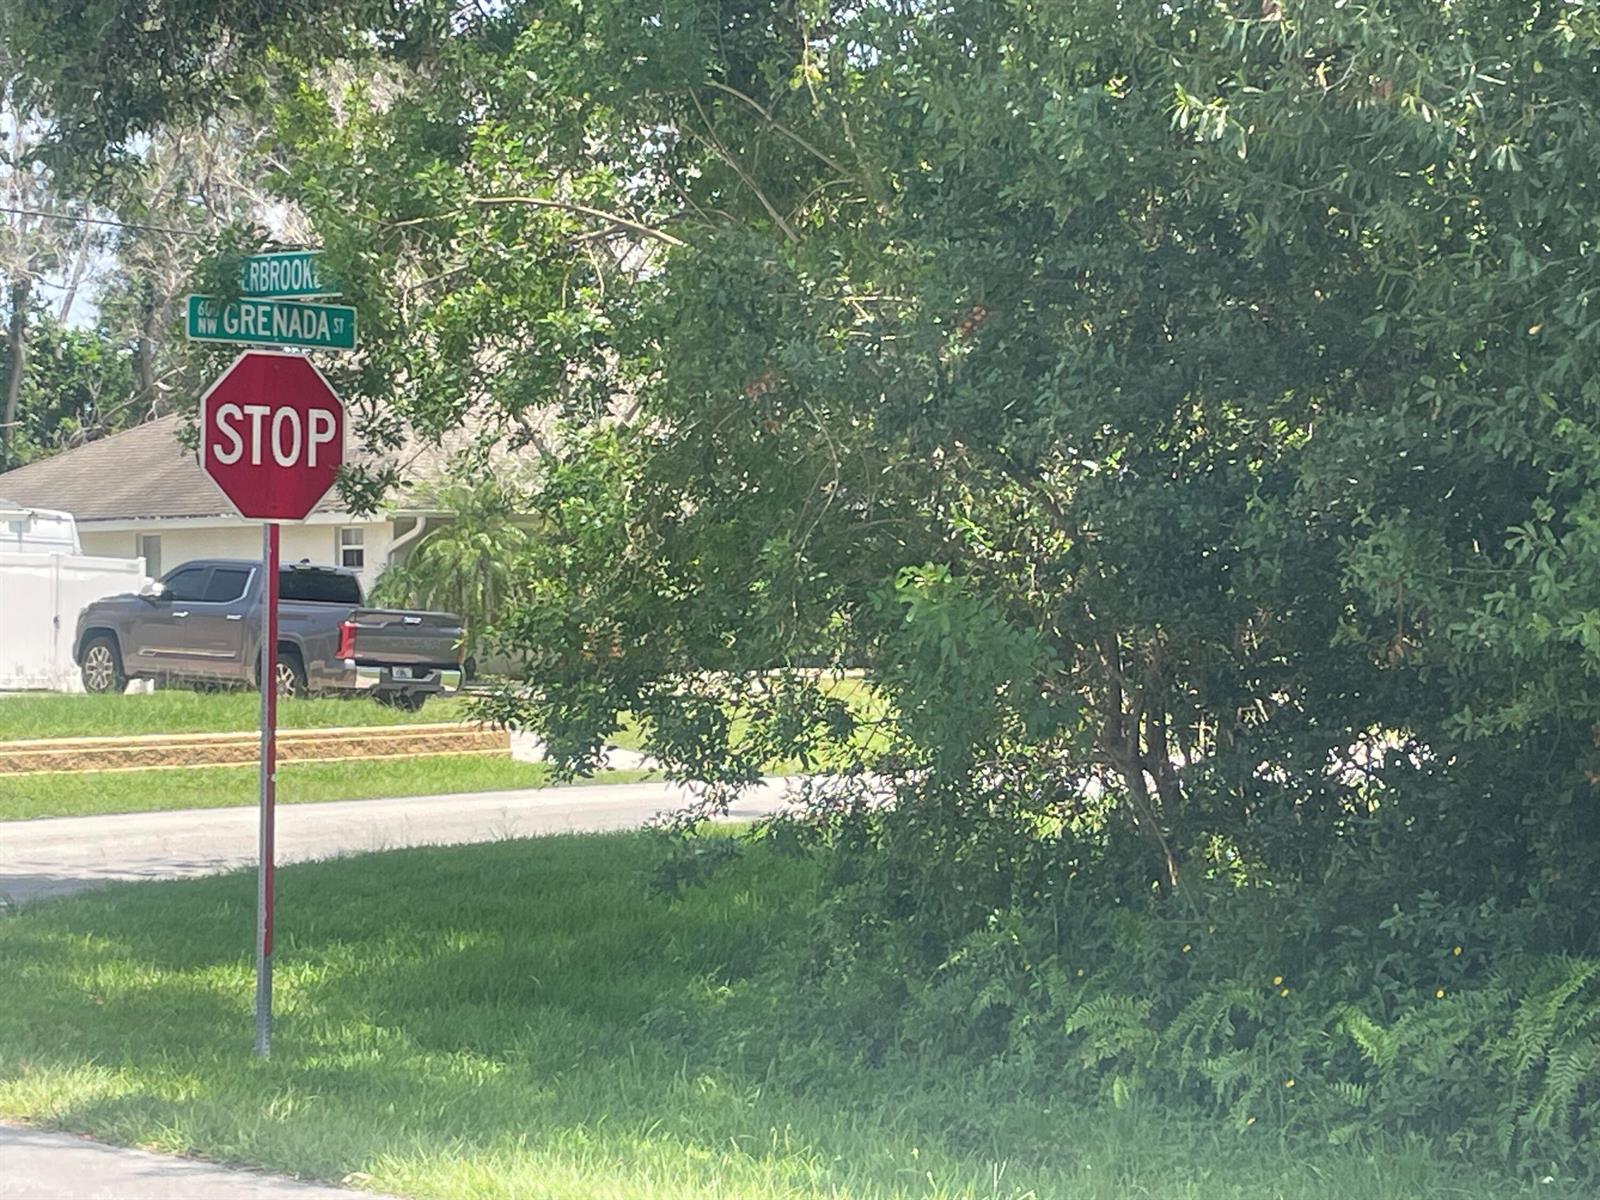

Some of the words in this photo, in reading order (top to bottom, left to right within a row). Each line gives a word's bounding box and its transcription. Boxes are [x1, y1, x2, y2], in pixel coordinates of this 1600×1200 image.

[198, 318, 217, 334] NW
[223, 303, 331, 341] GRENADA
[333, 317, 344, 334] ST
[212, 402, 337, 468] STOP
